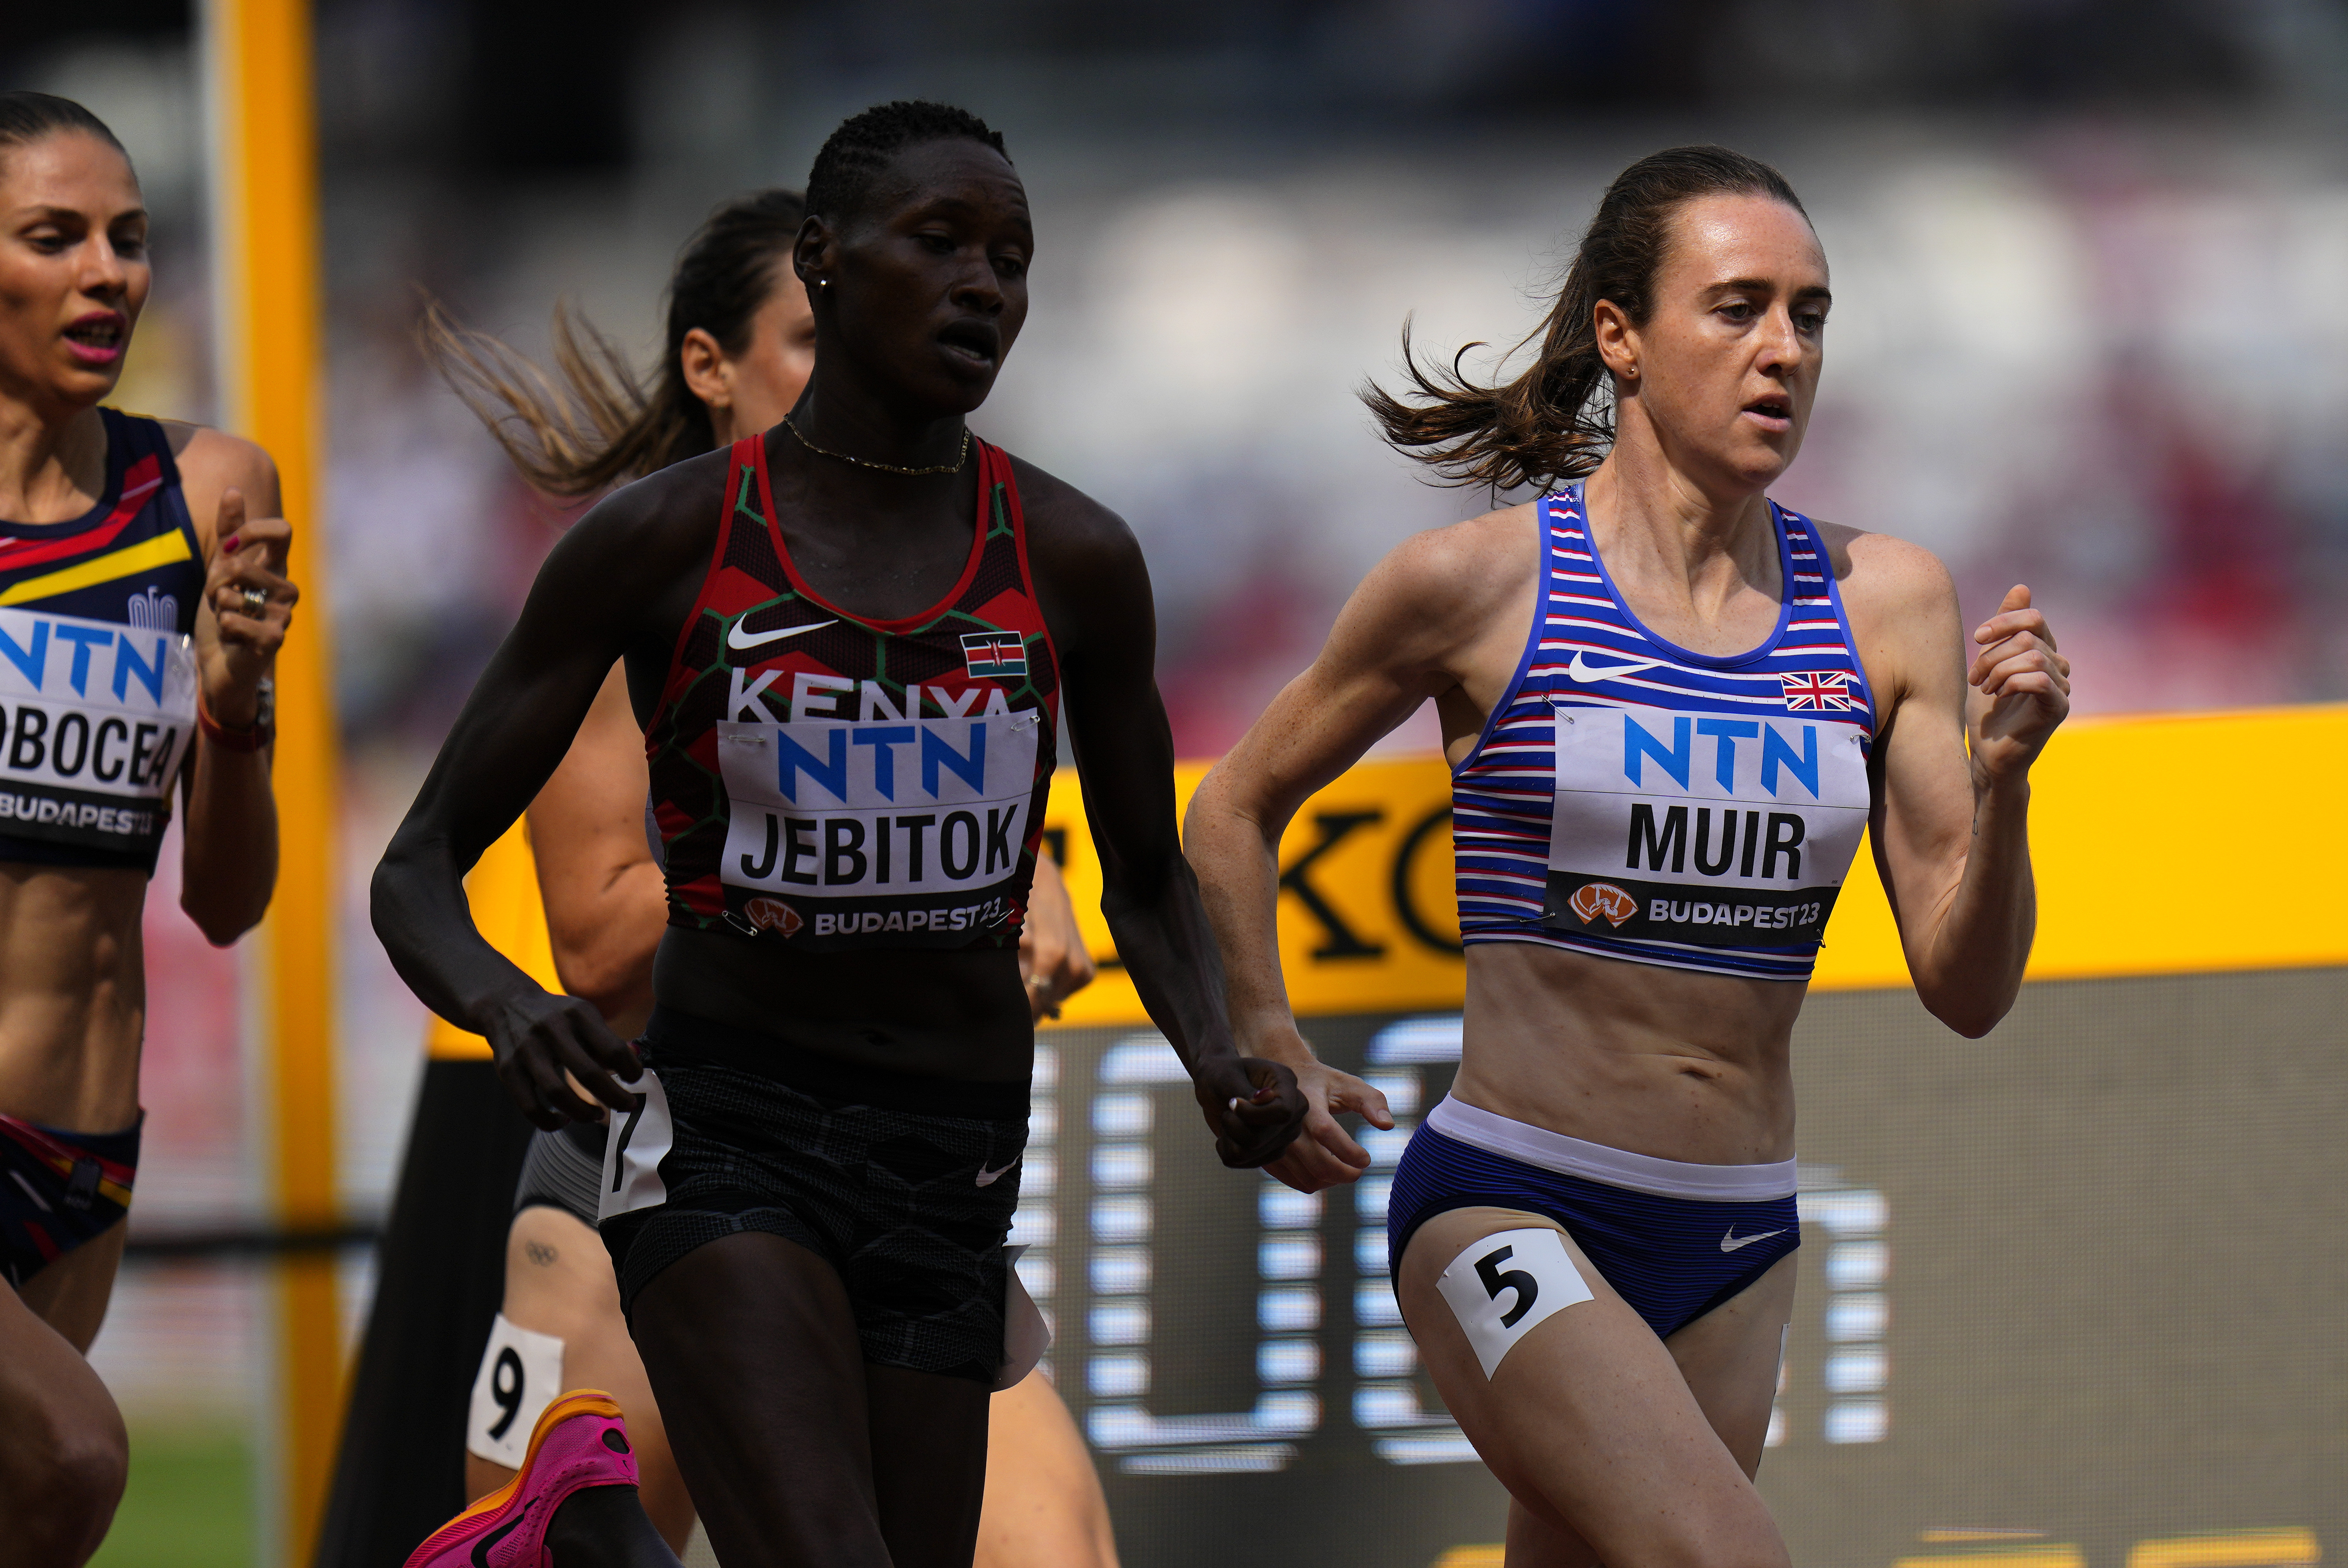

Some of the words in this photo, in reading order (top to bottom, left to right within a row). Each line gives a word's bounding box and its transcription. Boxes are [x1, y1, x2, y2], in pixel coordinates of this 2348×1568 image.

[0, 620, 166, 708] NTN
[0, 704, 176, 786] BOCEA
[777, 722, 986, 805] NTN
[1624, 713, 1819, 800] NTN
[740, 804, 1019, 885] JEBITOK
[1625, 803, 1806, 880] MUIR
[612, 1093, 647, 1193] 7
[1474, 1245, 1538, 1329] 5
[487, 1346, 524, 1443] 9
